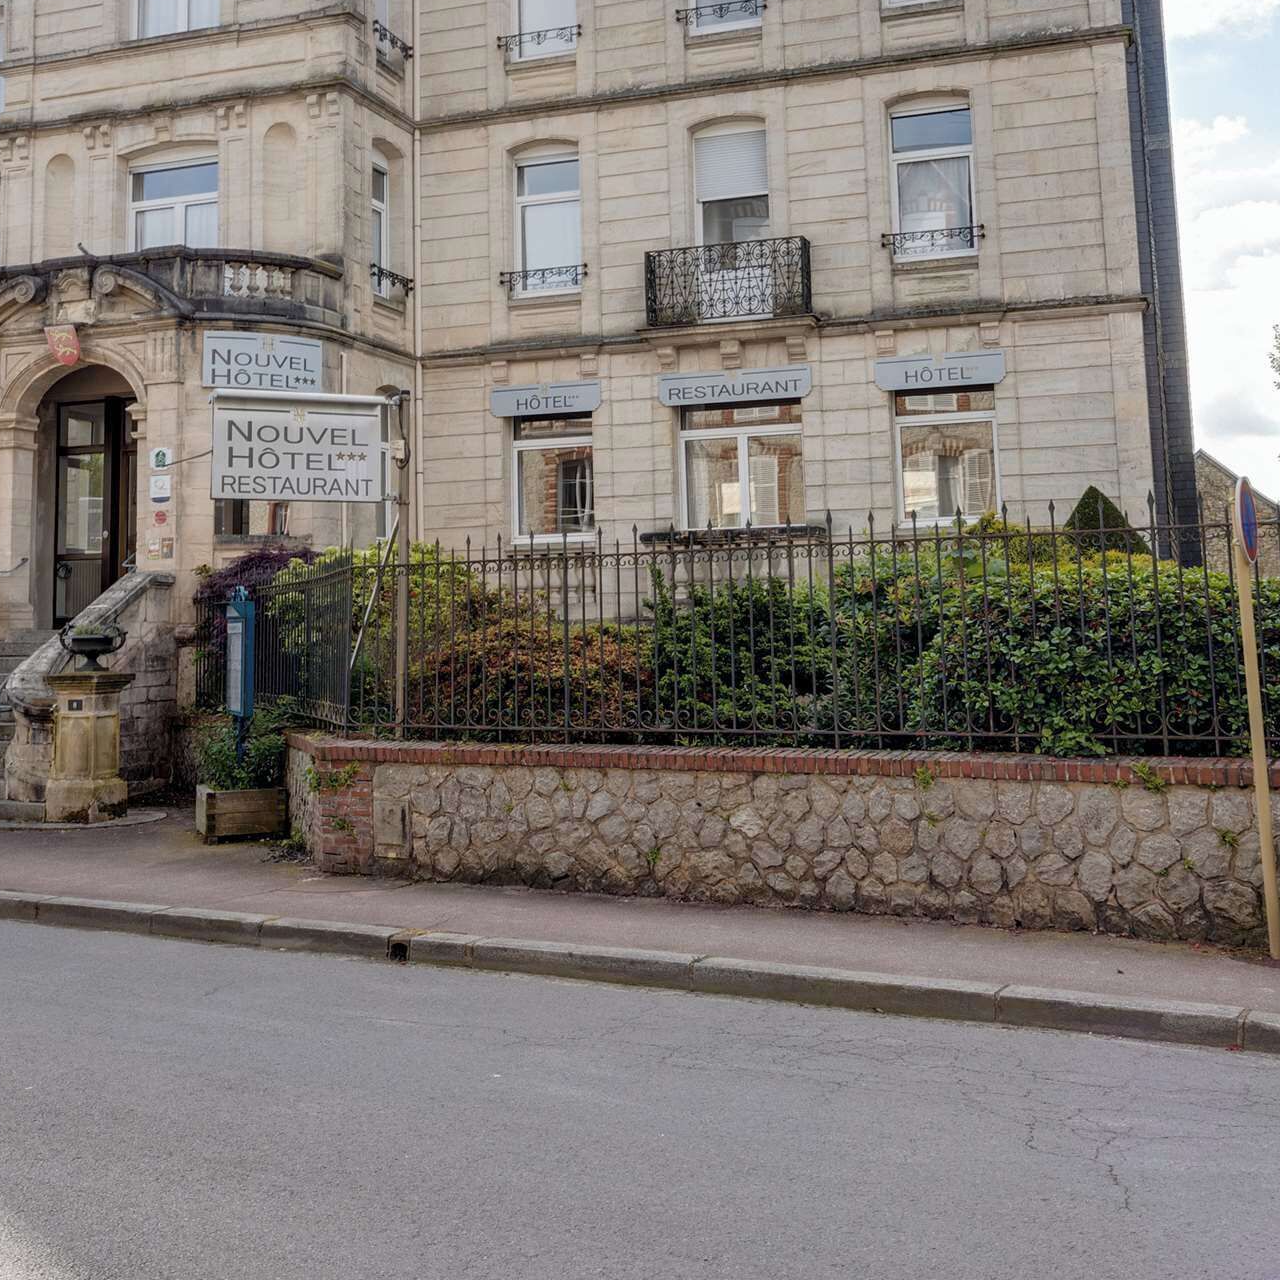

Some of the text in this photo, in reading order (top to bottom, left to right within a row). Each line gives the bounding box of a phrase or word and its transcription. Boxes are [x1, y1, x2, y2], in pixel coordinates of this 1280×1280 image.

[211, 348, 315, 373] NOUVEL
[211, 368, 298, 389] HÔTEL
[904, 366, 973, 384] HÔTEL
[668, 378, 803, 401] RESTAURANT
[516, 394, 574, 411] HÔTEL
[227, 419, 369, 447] NOUVEL
[227, 446, 346, 471] HÔTEL
[220, 474, 373, 497] RESTAURANT
